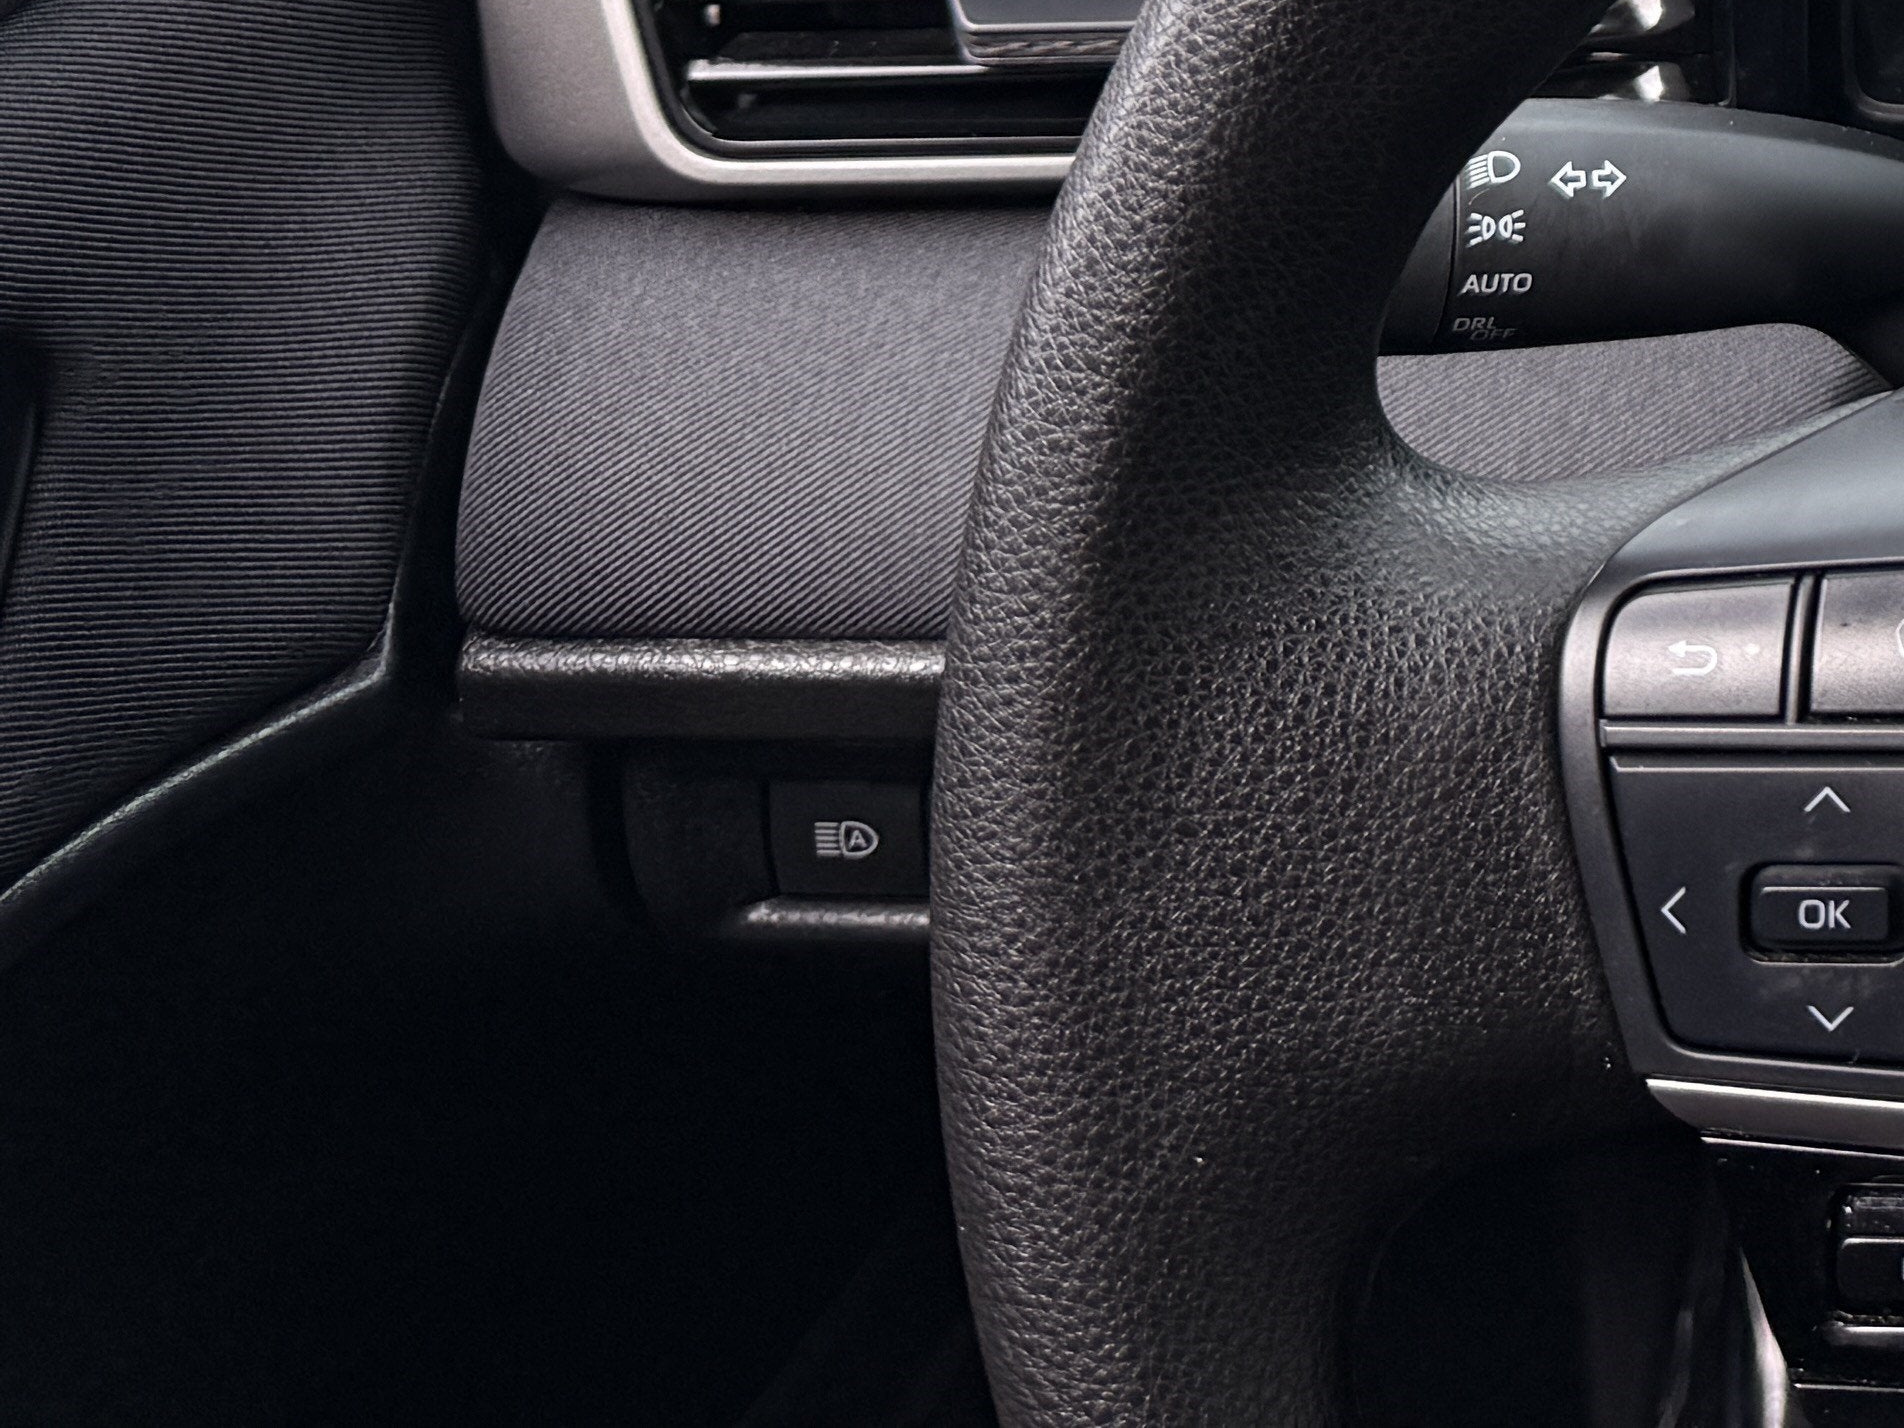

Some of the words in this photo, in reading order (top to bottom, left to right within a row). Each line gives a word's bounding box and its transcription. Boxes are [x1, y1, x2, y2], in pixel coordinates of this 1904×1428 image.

[1460, 273, 1533, 294] AUTO
[1451, 316, 1497, 332] DRL
[1469, 327, 1517, 342] OFF
[1798, 899, 1852, 930] OK
